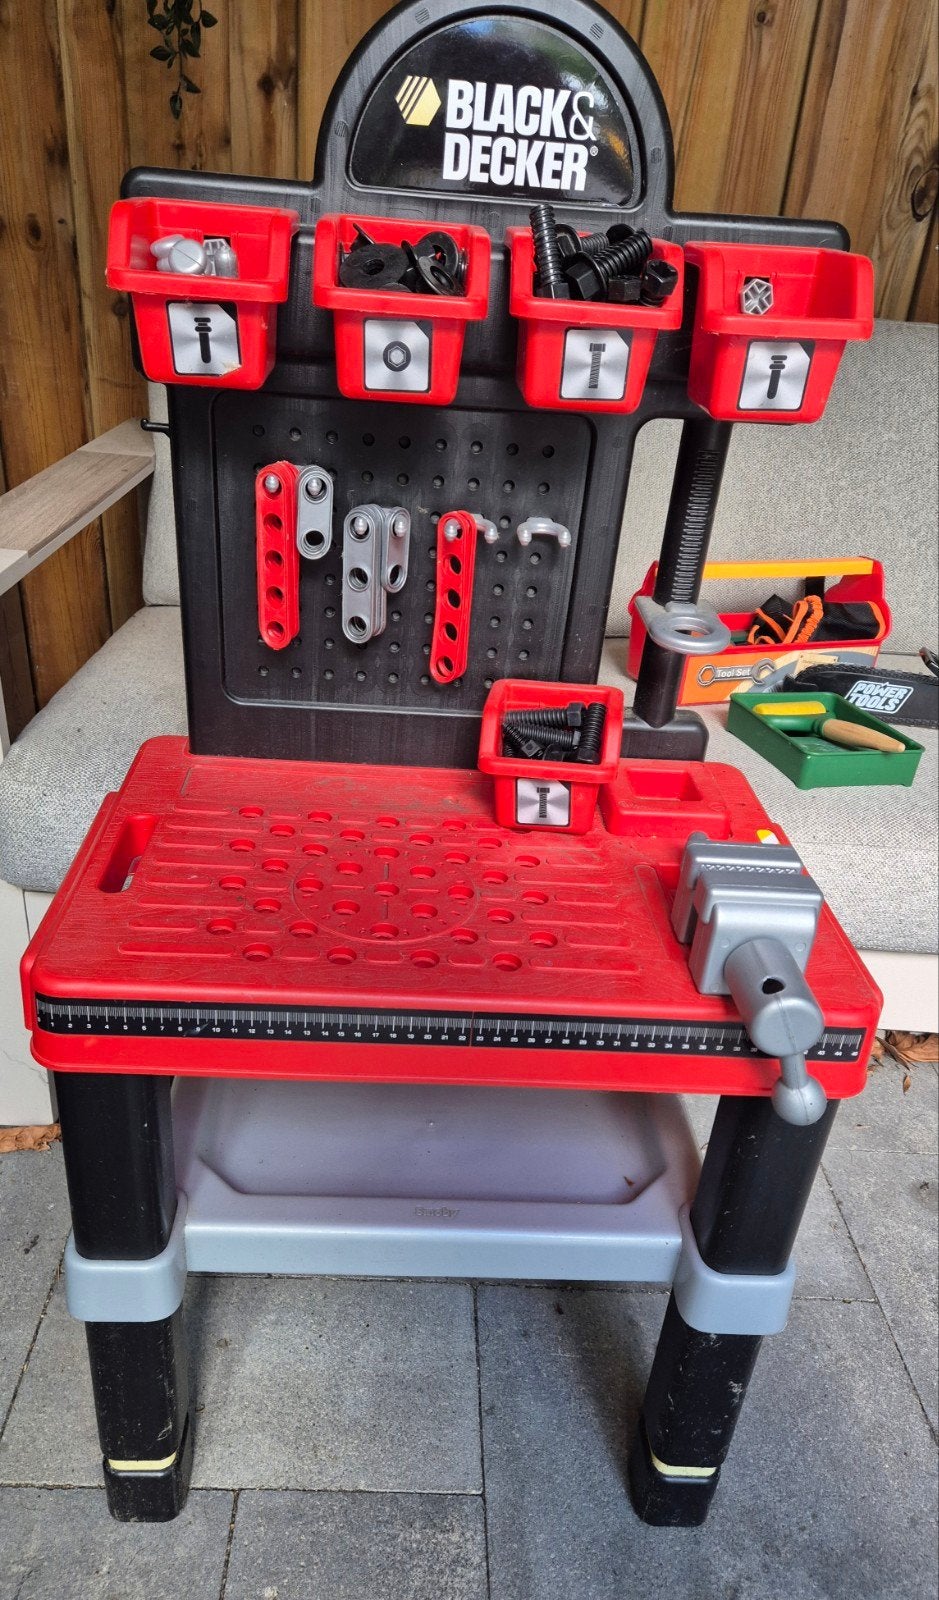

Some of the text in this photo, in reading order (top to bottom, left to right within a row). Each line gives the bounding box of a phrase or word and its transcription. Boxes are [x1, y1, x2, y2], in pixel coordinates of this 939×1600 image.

[717, 668, 751, 678] Tool Set
[853, 683, 908, 700] POWER
[848, 694, 900, 711] TOOLS
